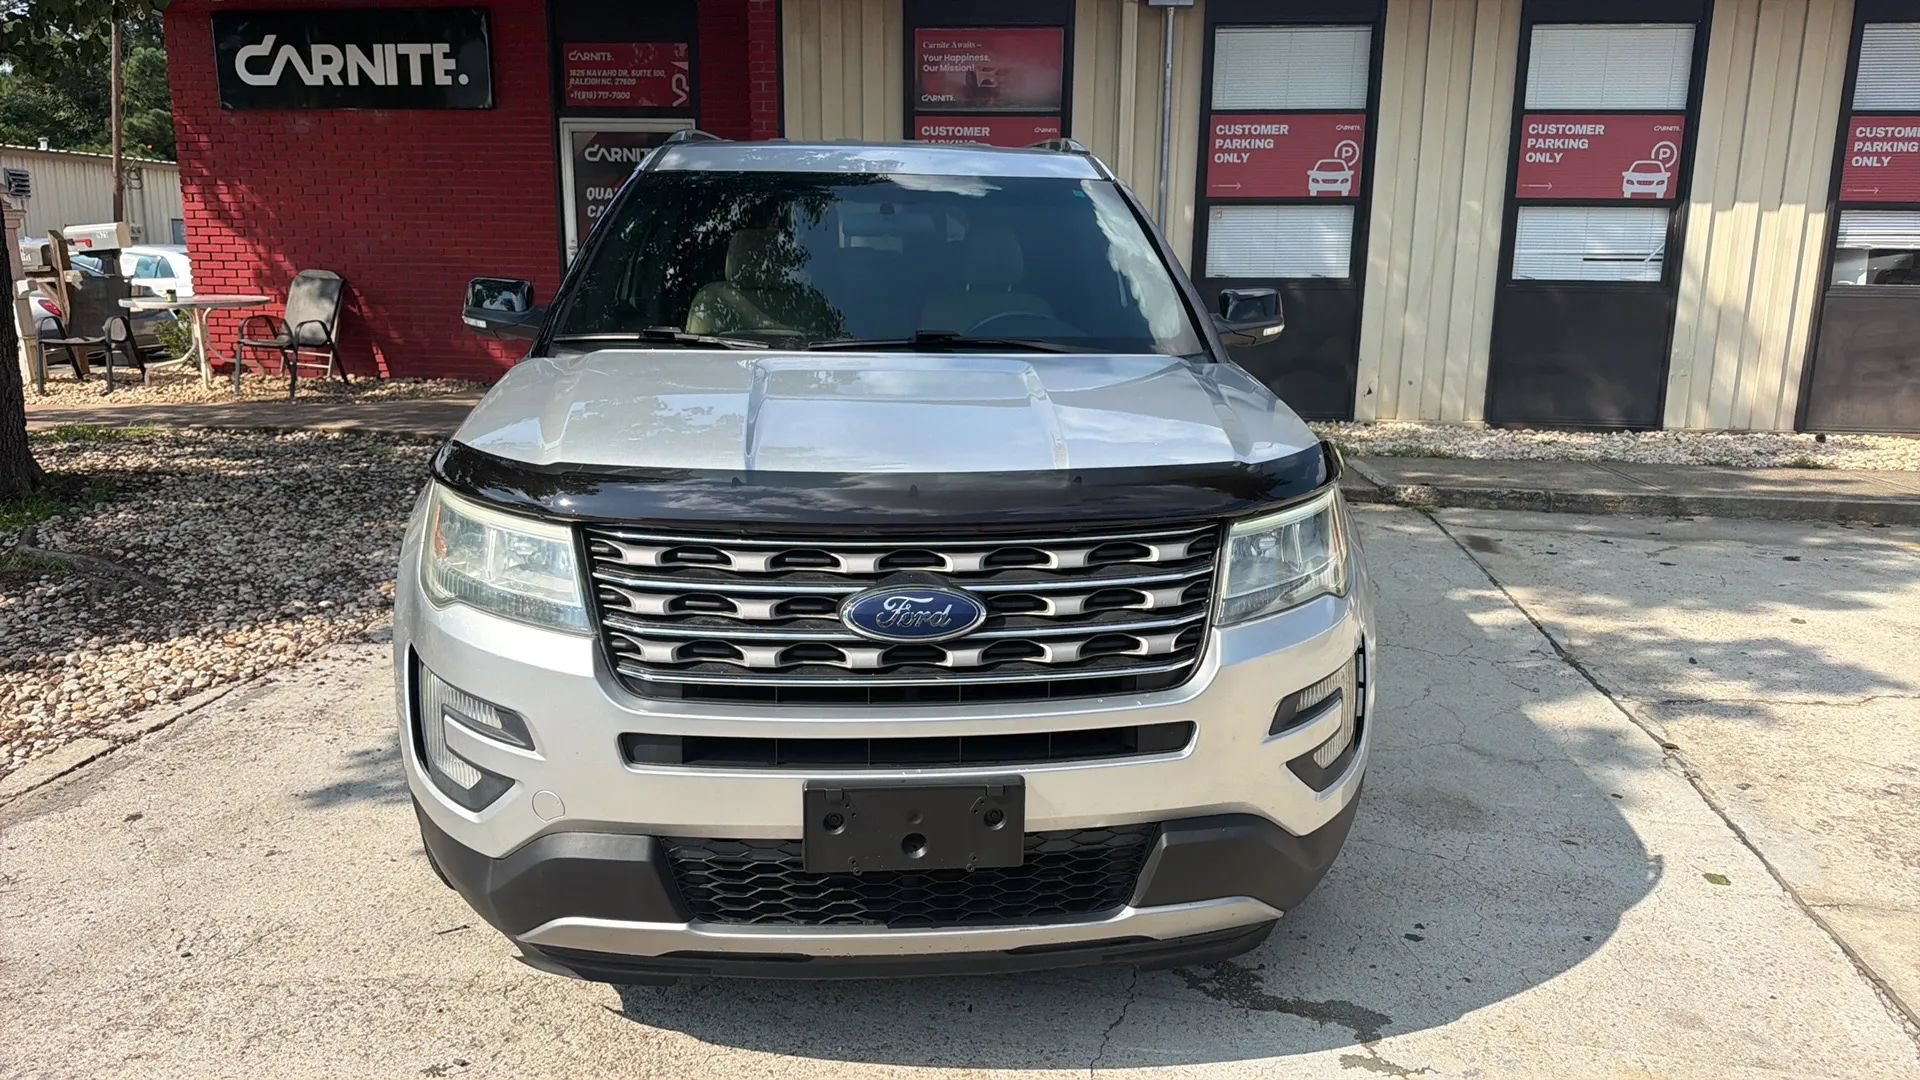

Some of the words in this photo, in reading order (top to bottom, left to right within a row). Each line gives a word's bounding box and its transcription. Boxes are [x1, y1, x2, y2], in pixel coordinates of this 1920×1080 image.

[951, 40, 976, 49] Awaits
[234, 34, 470, 86] CARNITE.
[922, 54, 943, 62] Your
[944, 53, 991, 64] Happiness,
[922, 64, 939, 72] Our
[940, 64, 975, 72] Mission!
[921, 126, 990, 136] CUSTOMER
[1216, 124, 1289, 135] CUSTOMER
[1528, 124, 1605, 135] CUSTOMER
[1855, 127, 1920, 138] CUSTOM
[1215, 139, 1274, 149] PARKING
[1527, 138, 1589, 149] PARKING
[1853, 141, 1919, 152] PARKING
[584, 144, 652, 162] CARNIT
[1214, 153, 1250, 163] ONLY
[1342, 147, 1353, 159] P
[1525, 152, 1563, 163] ONLY
[1658, 148, 1671, 160] P
[1851, 156, 1892, 167] ONLY
[875, 596, 952, 629] Ford
